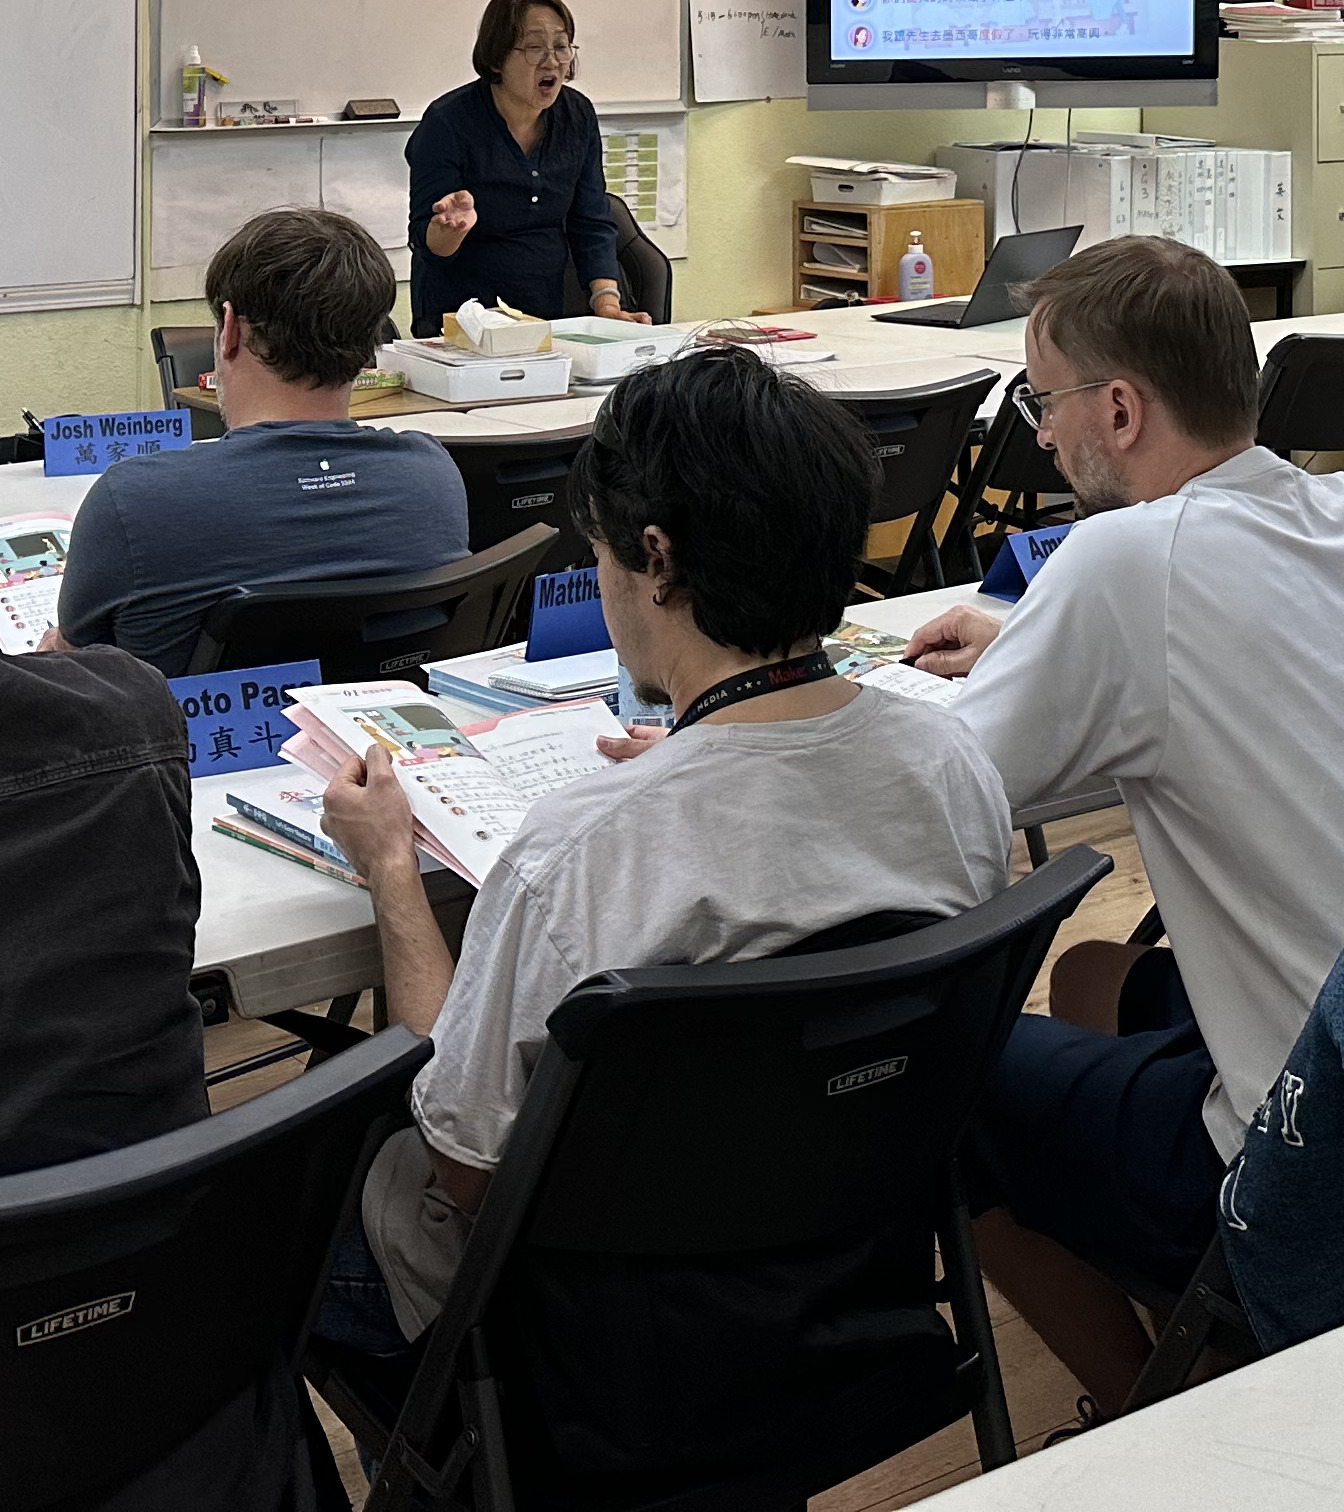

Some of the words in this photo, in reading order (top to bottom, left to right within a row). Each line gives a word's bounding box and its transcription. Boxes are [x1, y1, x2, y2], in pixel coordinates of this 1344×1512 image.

[50, 419, 94, 441] Josh
[99, 416, 183, 438] Weinberg
[240, 680, 315, 711] Pag
[835, 1059, 898, 1092] LIFETIME
[31, 1296, 123, 1342] LIFETIME
